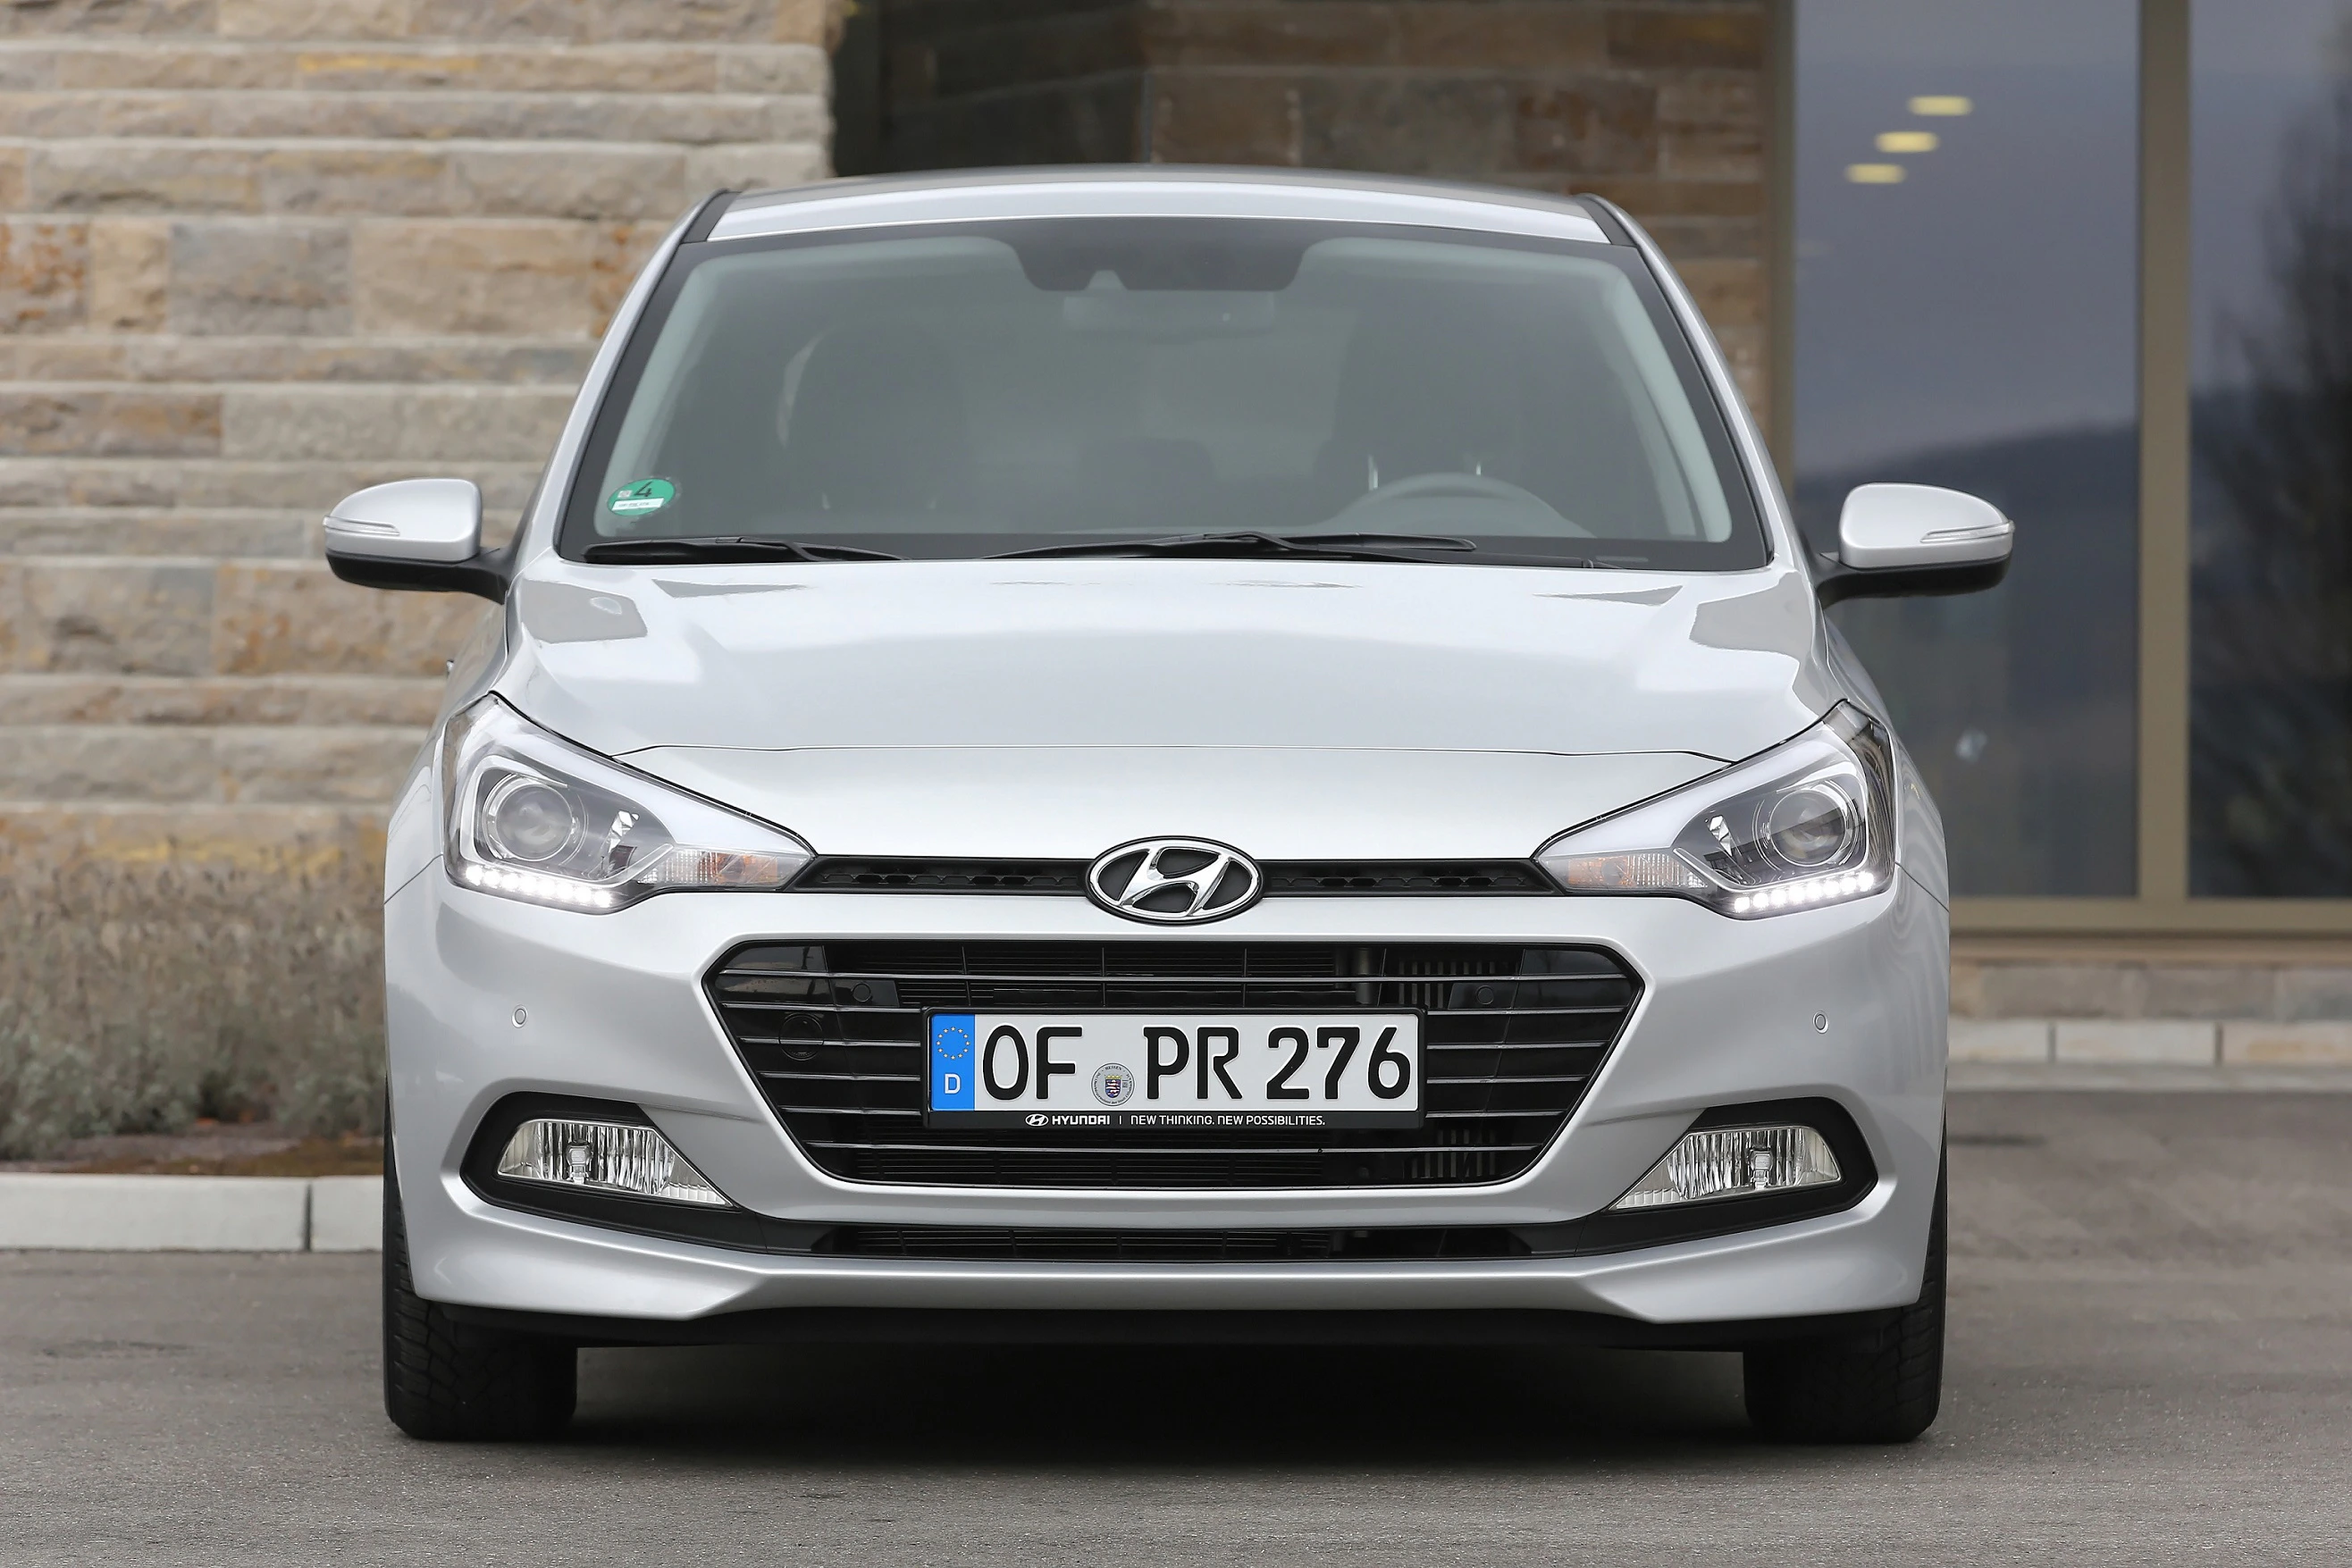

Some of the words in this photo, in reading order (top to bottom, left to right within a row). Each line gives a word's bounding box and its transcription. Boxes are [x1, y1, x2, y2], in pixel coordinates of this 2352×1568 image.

[634, 481, 653, 498] 4
[983, 1026, 1083, 1100] OF
[1143, 1027, 1243, 1100] PR
[1266, 1027, 1411, 1100] 276
[945, 1073, 961, 1094] D
[1052, 1115, 1111, 1126] HYUNDAI
[1130, 1115, 1157, 1125] NEW
[1159, 1115, 1215, 1126] THINKING.
[1217, 1115, 1244, 1126] NEW
[1246, 1115, 1326, 1126] POSSIBILITIES.
